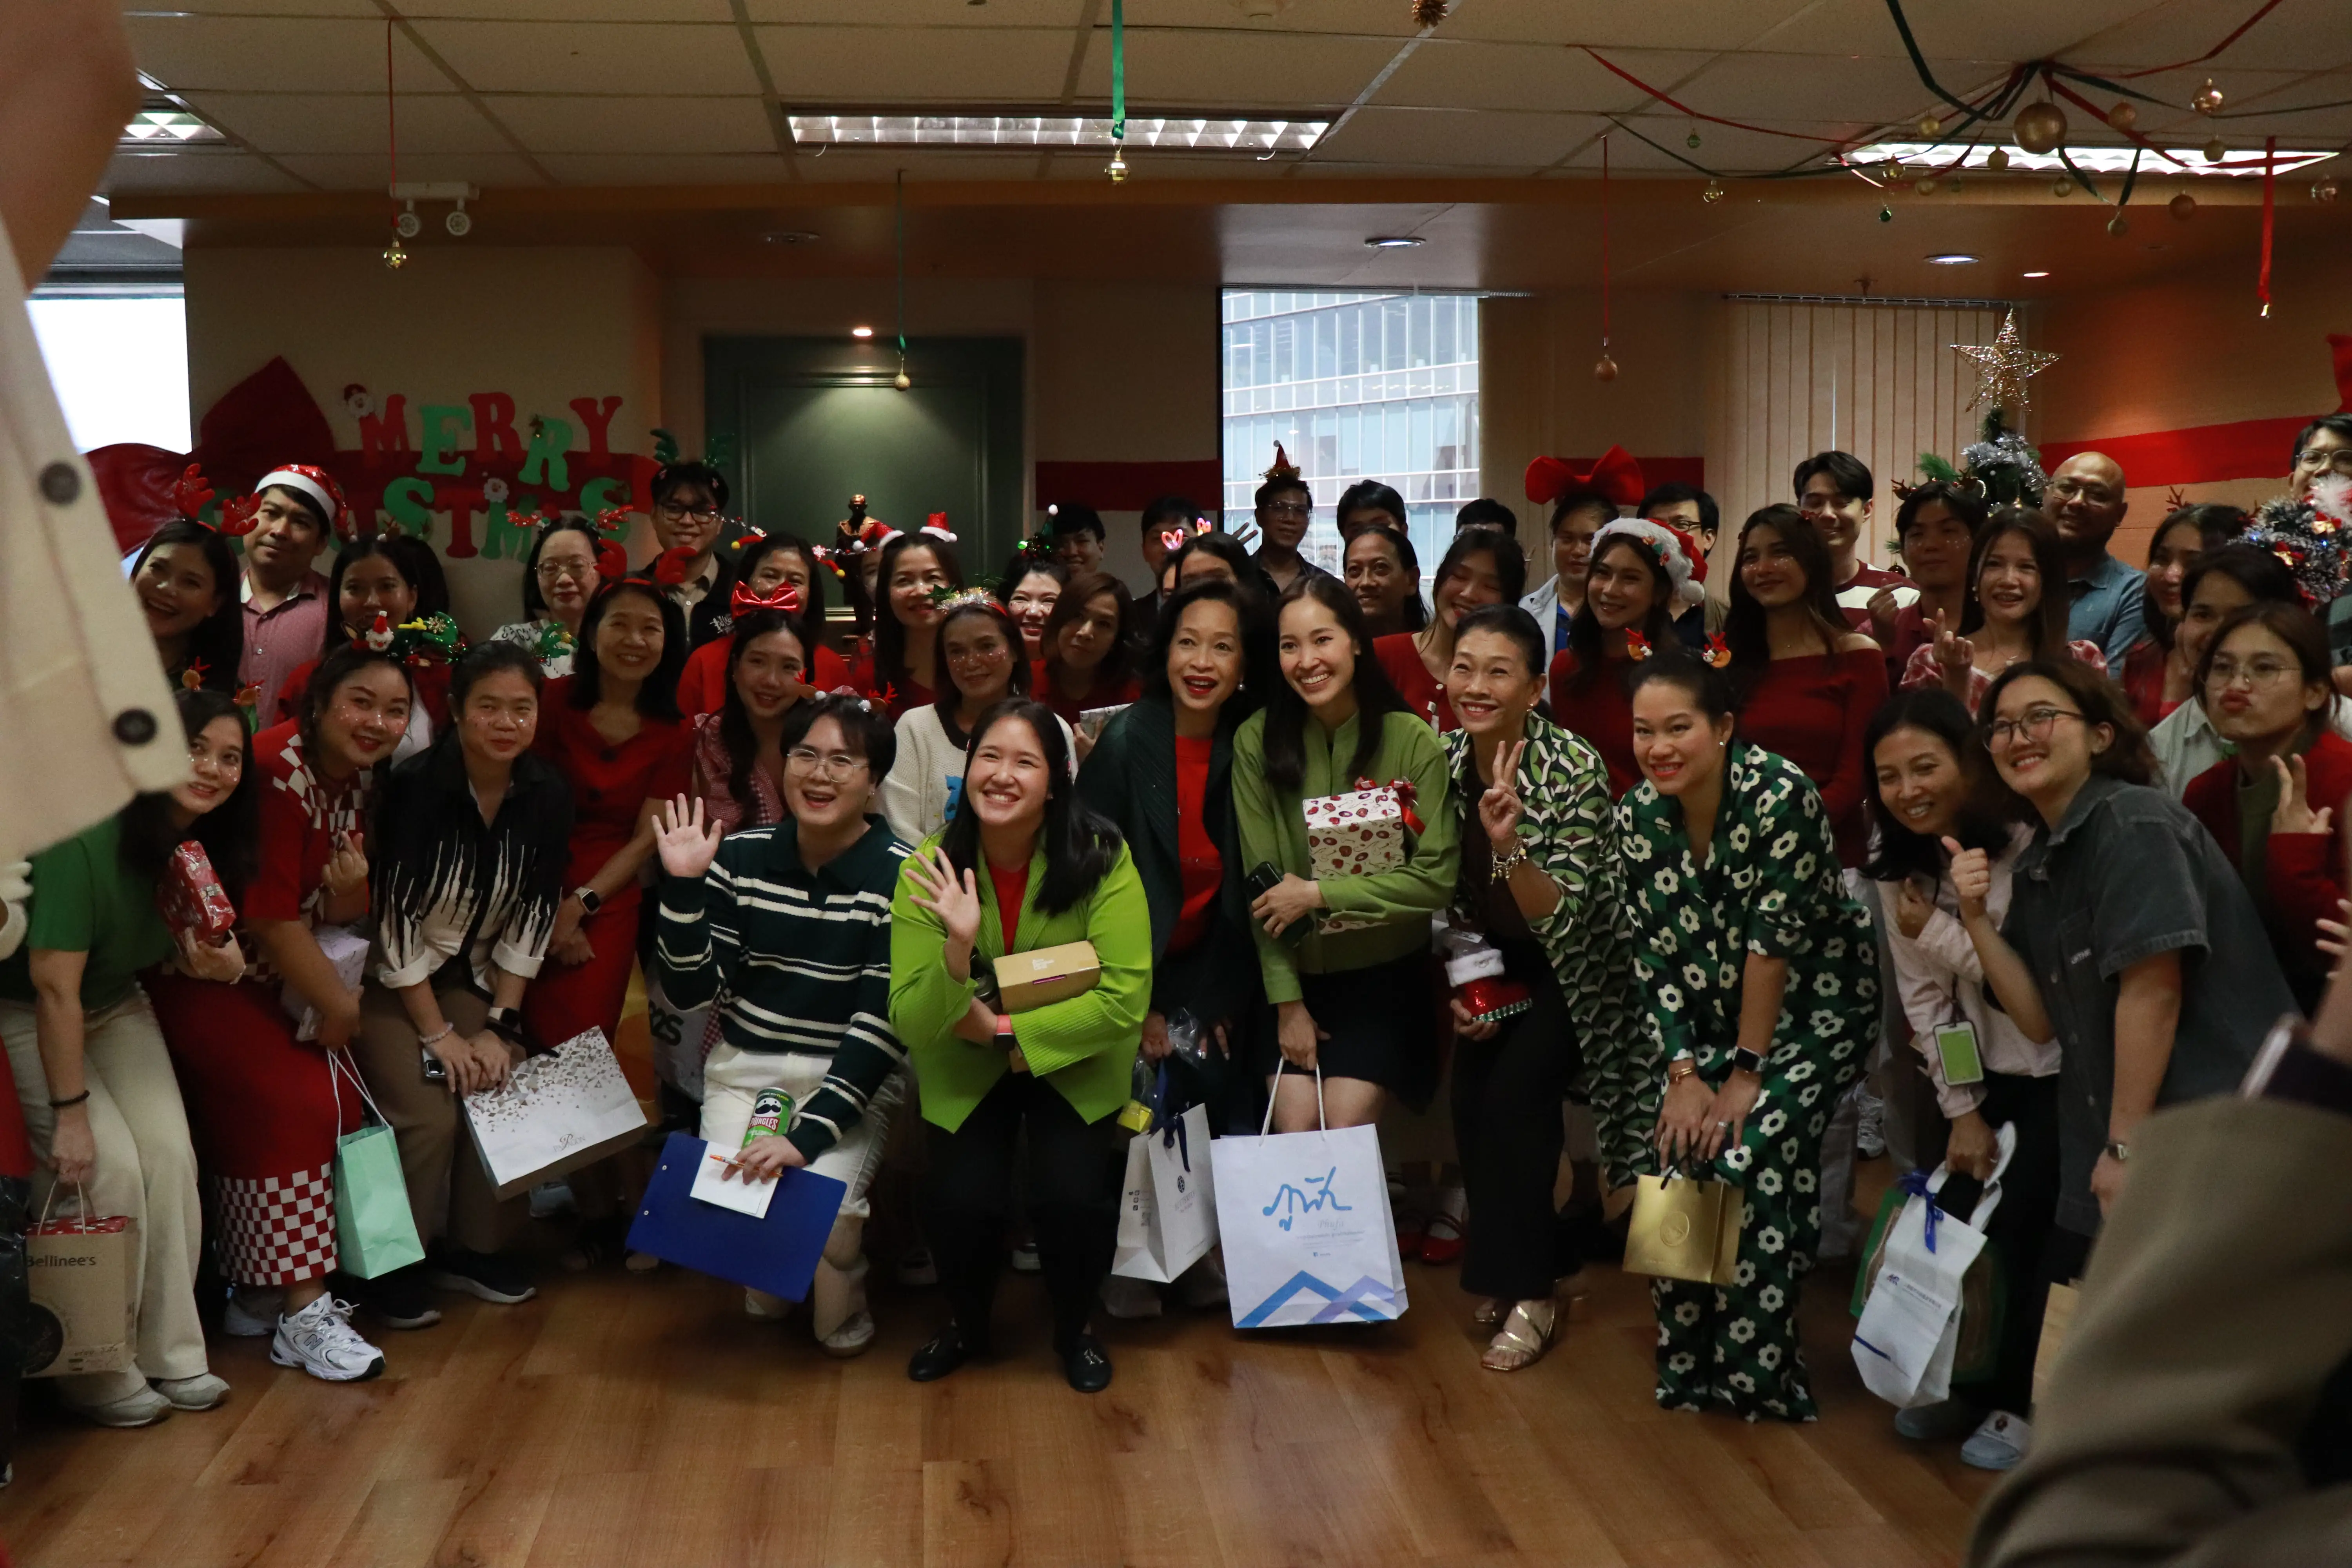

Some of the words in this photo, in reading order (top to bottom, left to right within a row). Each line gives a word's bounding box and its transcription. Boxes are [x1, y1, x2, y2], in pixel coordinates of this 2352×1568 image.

[359, 392, 623, 492] MERRY
[749, 1117, 778, 1130] PRINGLES
[27, 1255, 96, 1267] Bellinee's
